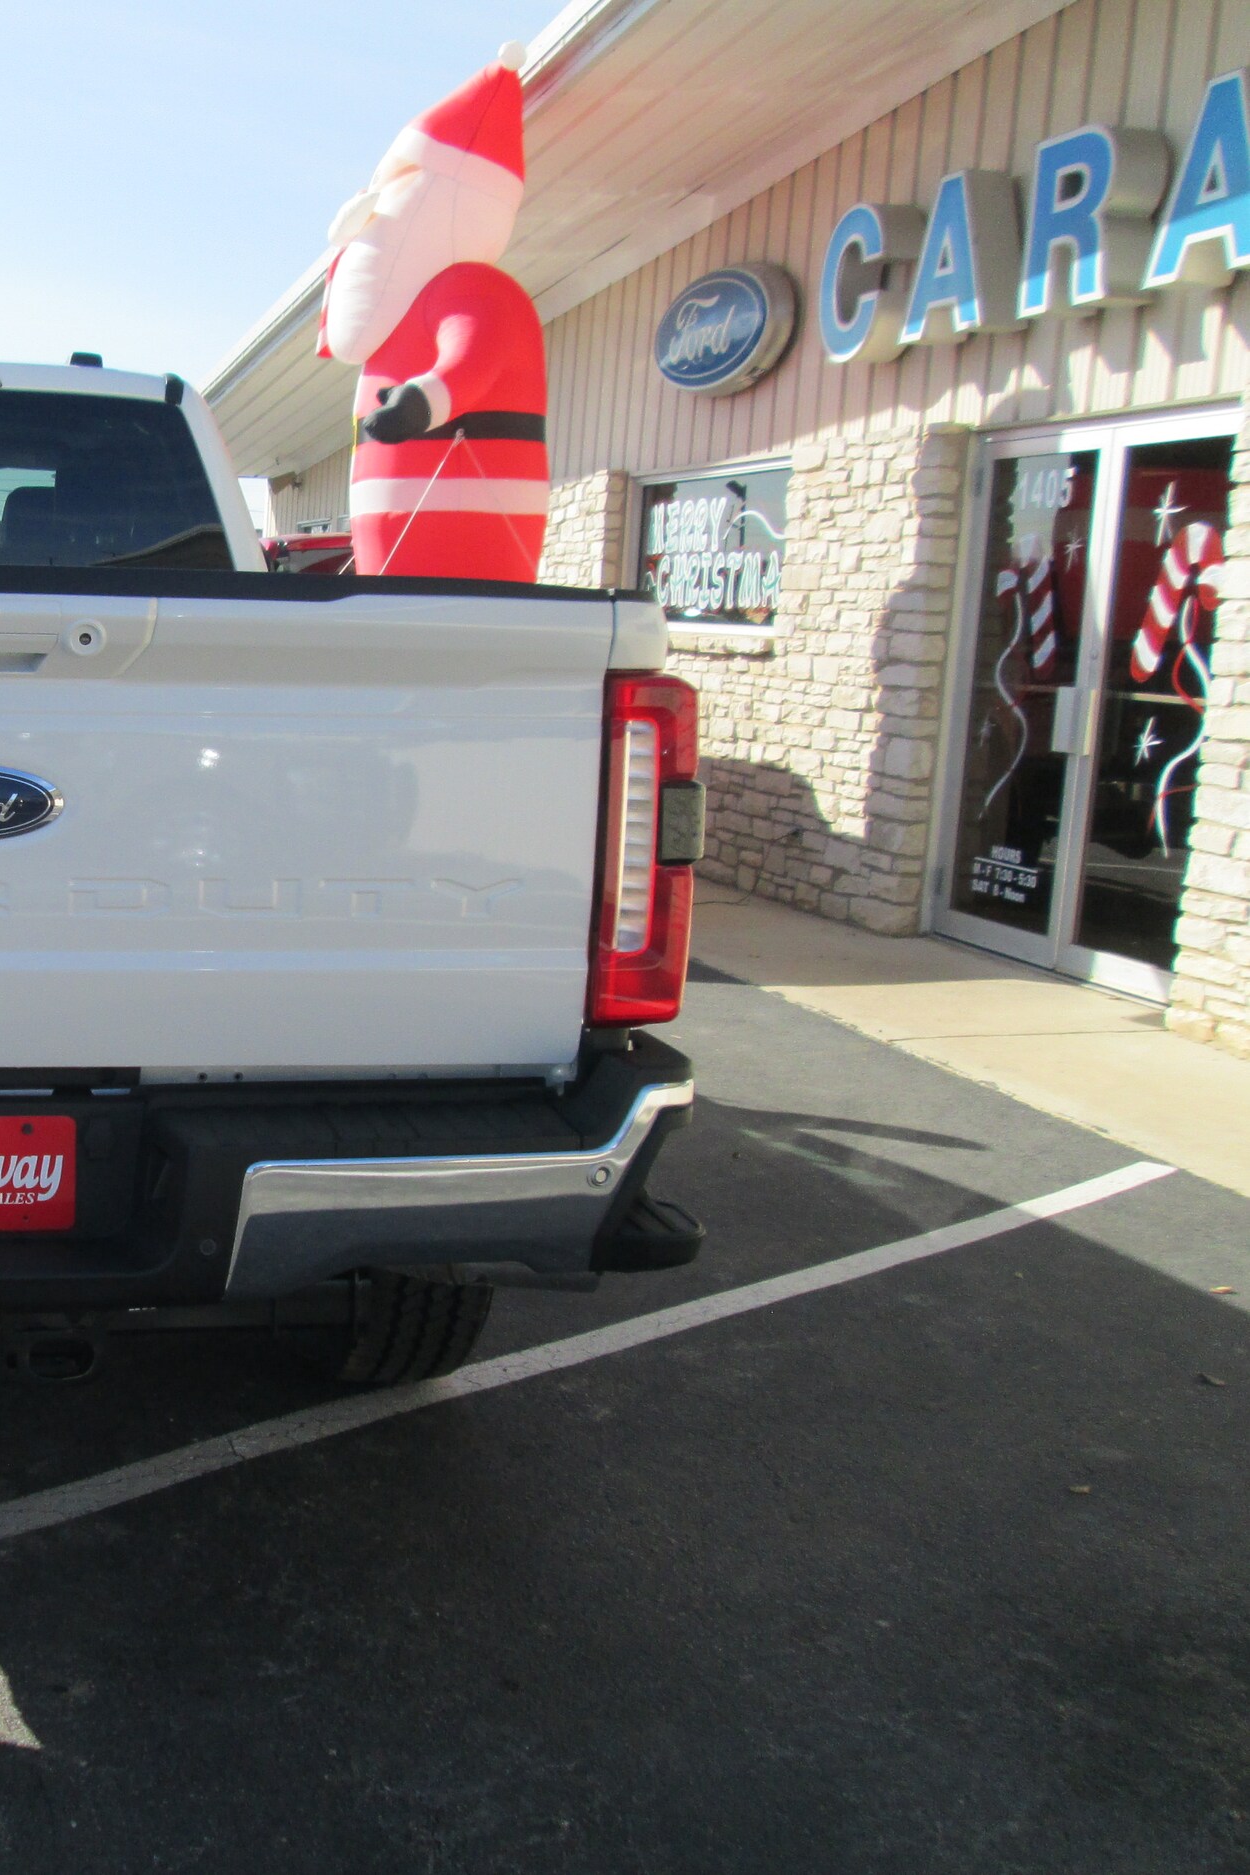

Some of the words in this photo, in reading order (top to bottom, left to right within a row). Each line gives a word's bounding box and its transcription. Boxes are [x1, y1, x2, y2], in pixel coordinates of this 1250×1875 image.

[818, 68, 1250, 364] CARA
[668, 294, 736, 365] Ford
[1016, 466, 1076, 510] 1405
[649, 496, 728, 554] MERRY
[991, 846, 1021, 864] HOURS
[66, 876, 526, 918] DUTY
